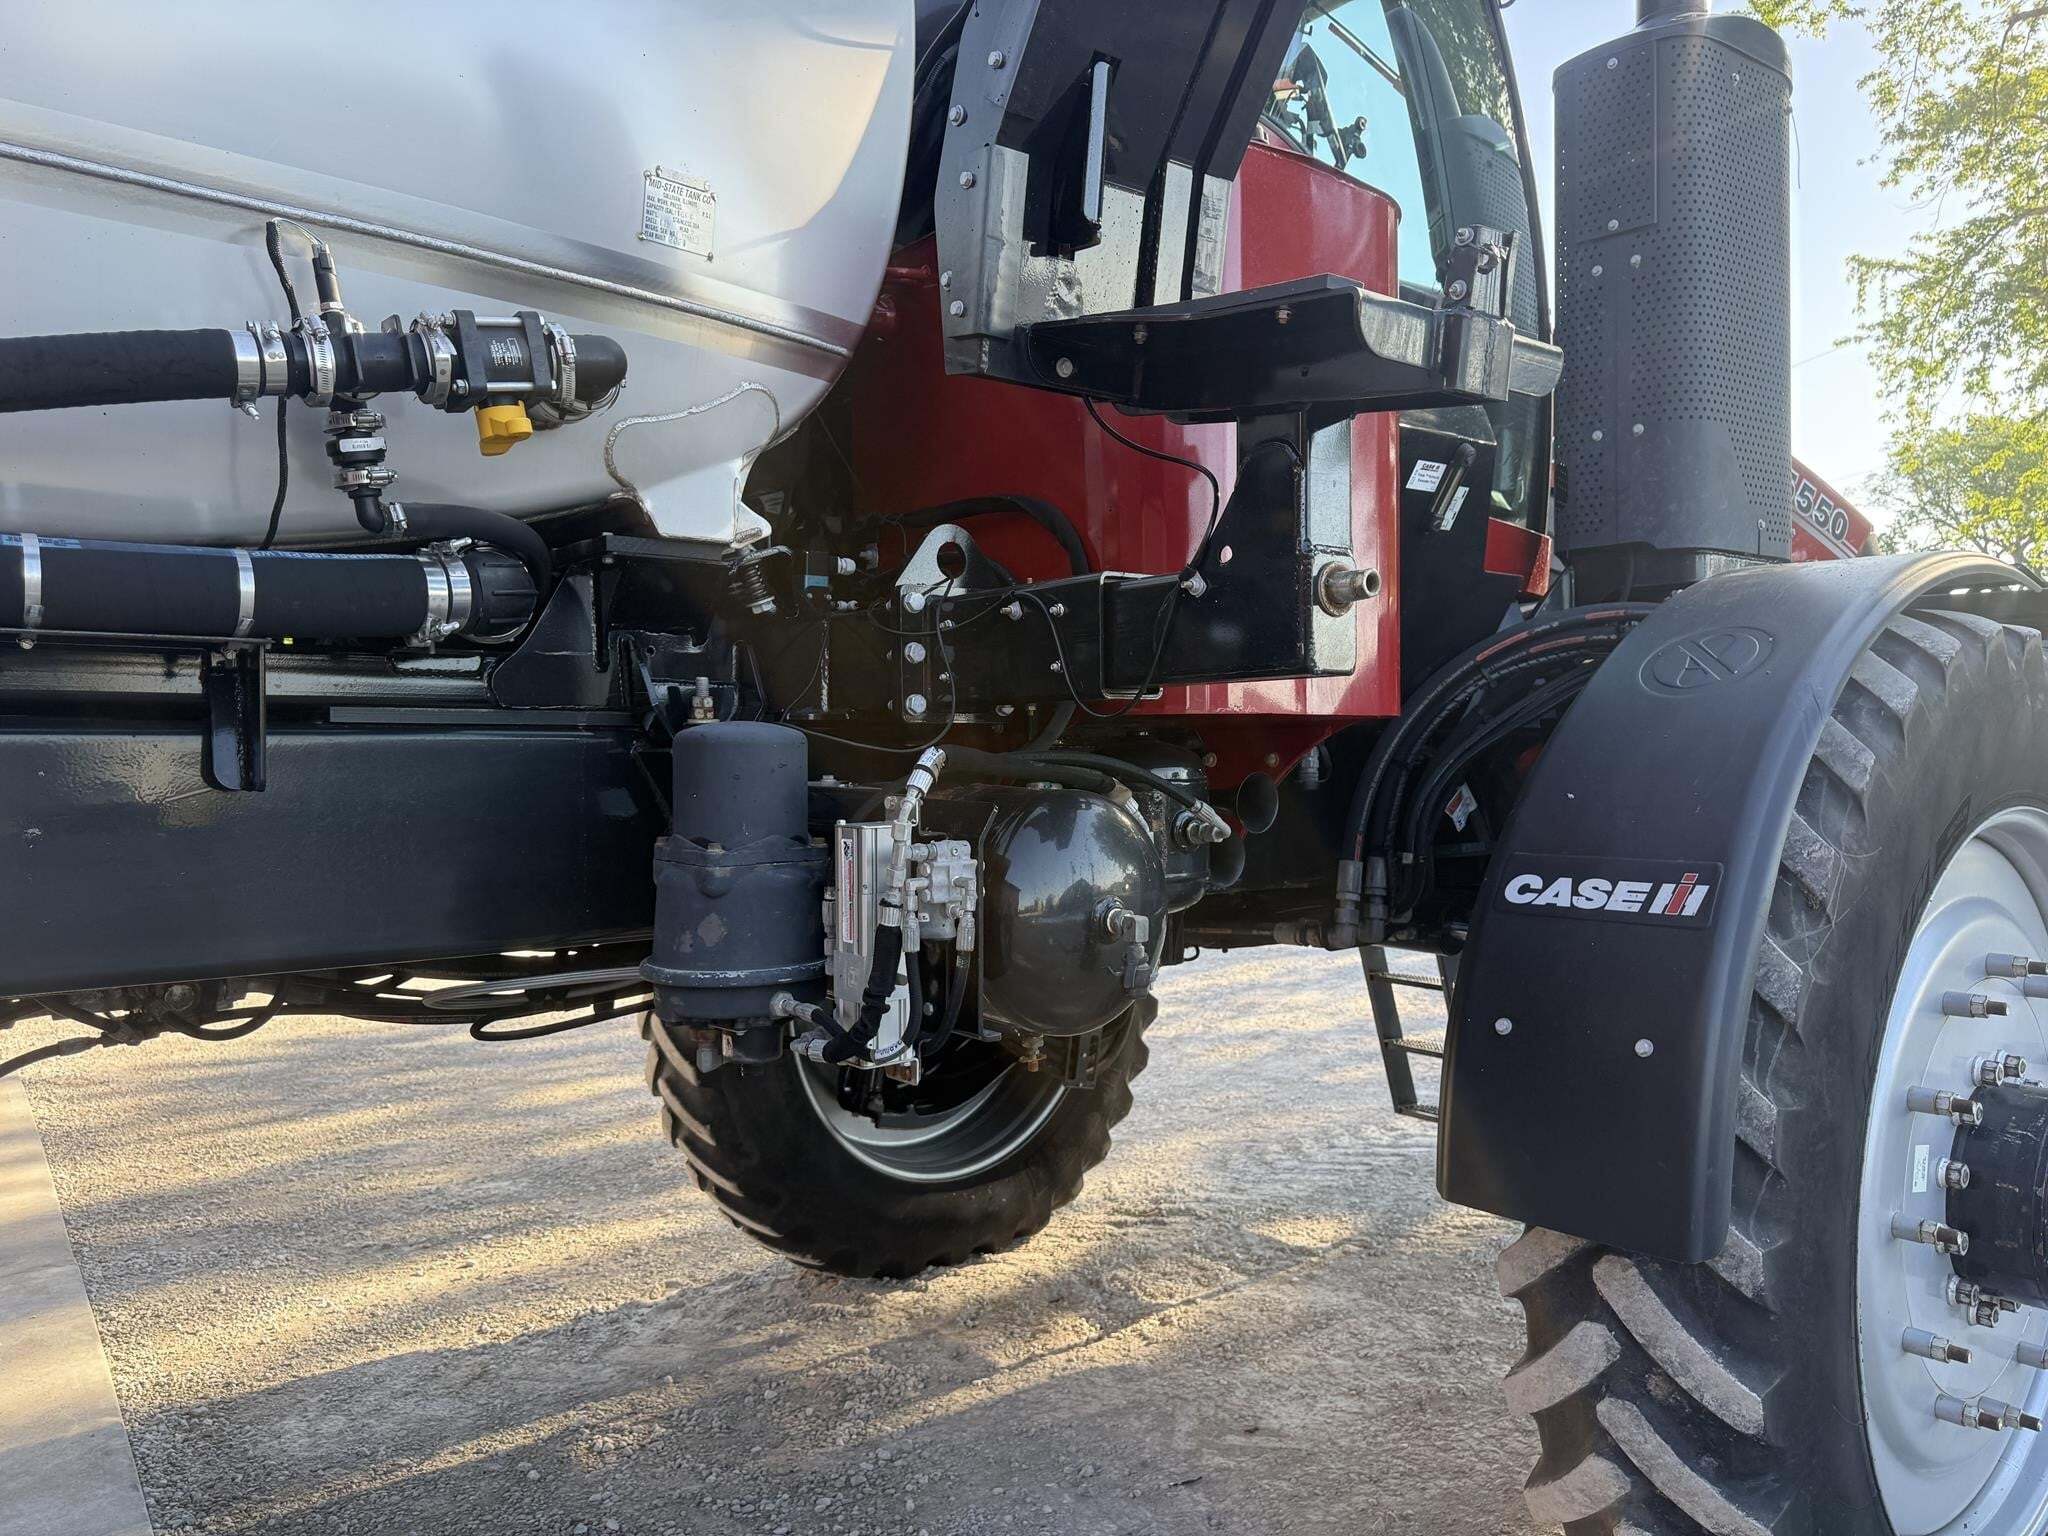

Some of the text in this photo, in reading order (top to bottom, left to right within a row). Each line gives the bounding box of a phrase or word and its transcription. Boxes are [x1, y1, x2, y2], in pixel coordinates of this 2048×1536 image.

[648, 177, 684, 197] MID-STATE
[685, 189, 701, 202] TANK
[1504, 873, 1653, 913] CASE
